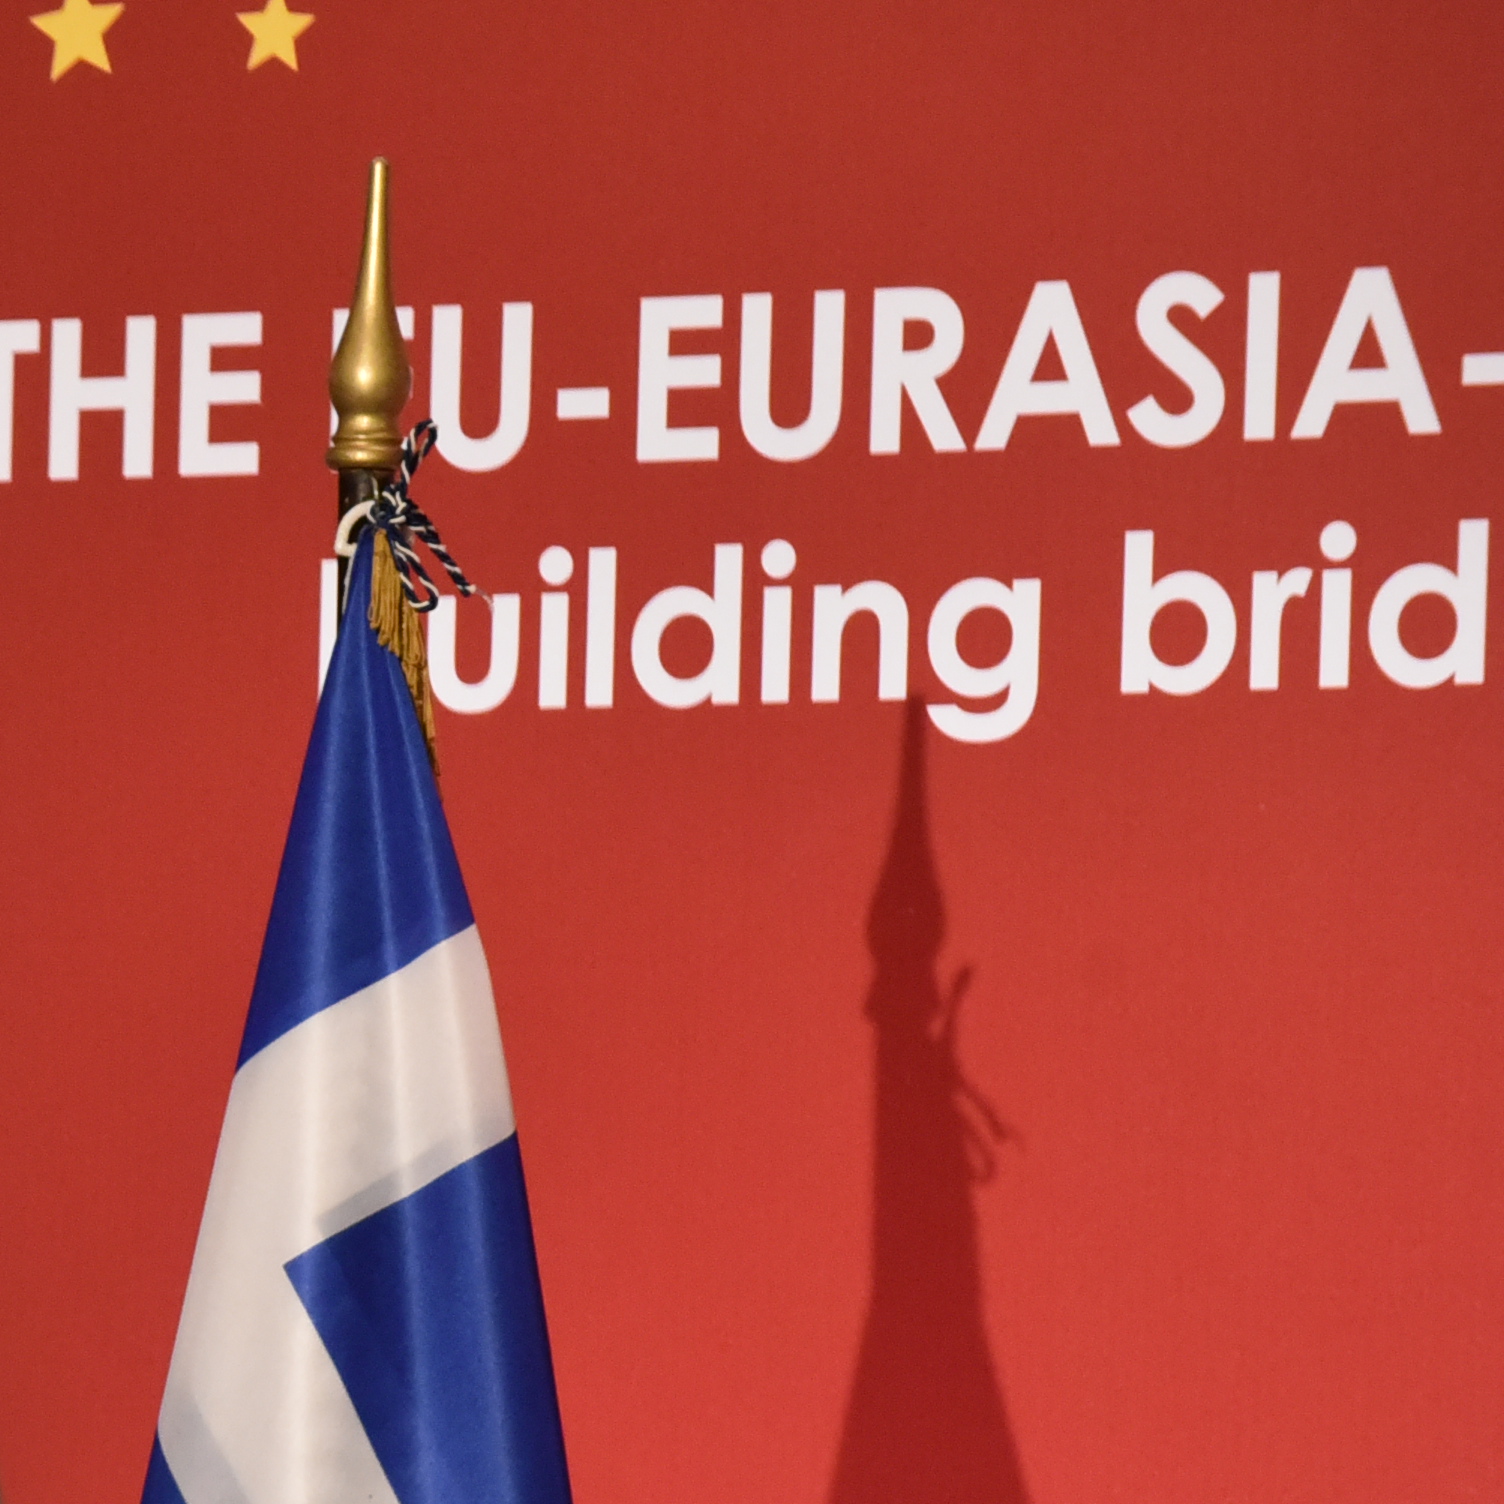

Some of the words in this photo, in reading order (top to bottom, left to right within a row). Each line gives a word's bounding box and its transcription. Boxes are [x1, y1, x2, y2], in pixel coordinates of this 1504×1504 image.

[329, 266, 1504, 473] U-EURASIA-
[317, 538, 1042, 744] uilding
[1120, 518, 1490, 696] brid
